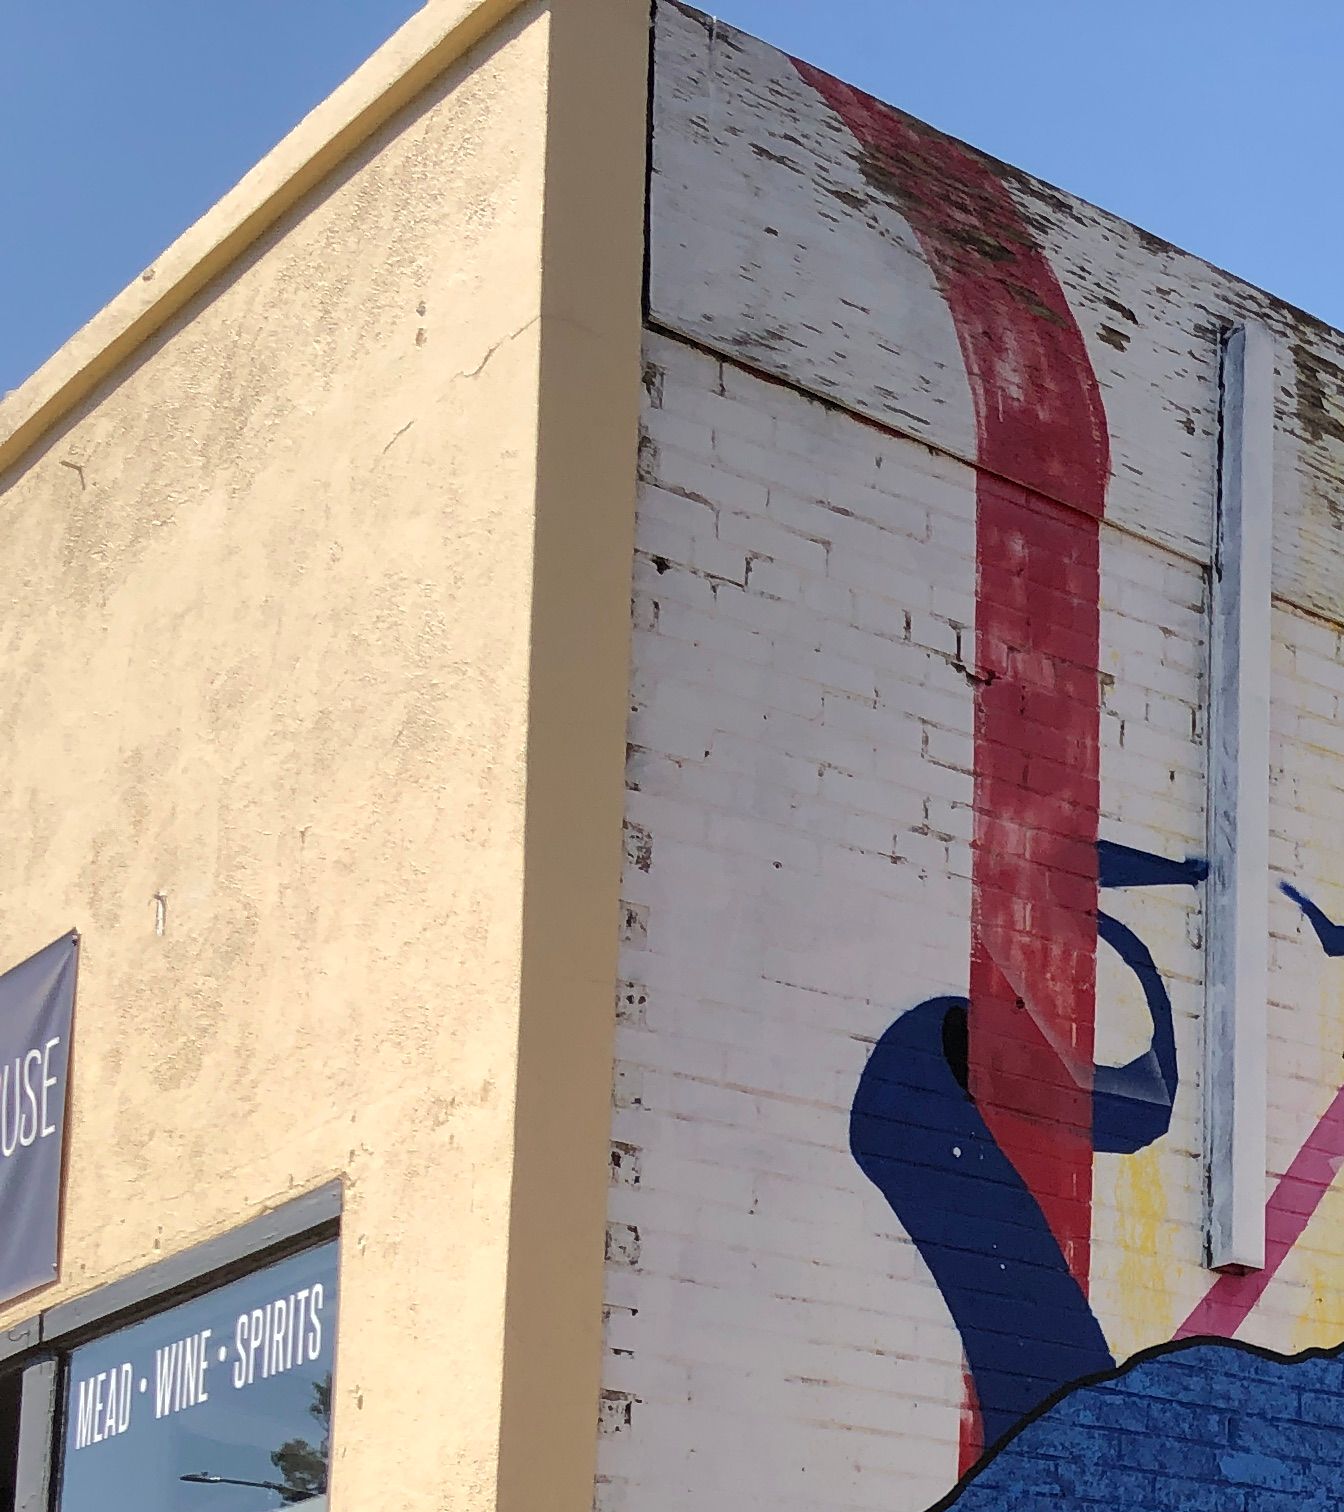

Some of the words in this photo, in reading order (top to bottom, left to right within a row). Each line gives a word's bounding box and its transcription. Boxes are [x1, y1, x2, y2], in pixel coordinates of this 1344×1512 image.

[0, 1036, 60, 1157] USE
[75, 1362, 133, 1450] MEAD
[155, 1328, 212, 1419] WINE
[233, 1282, 324, 1390] SPIRITS
